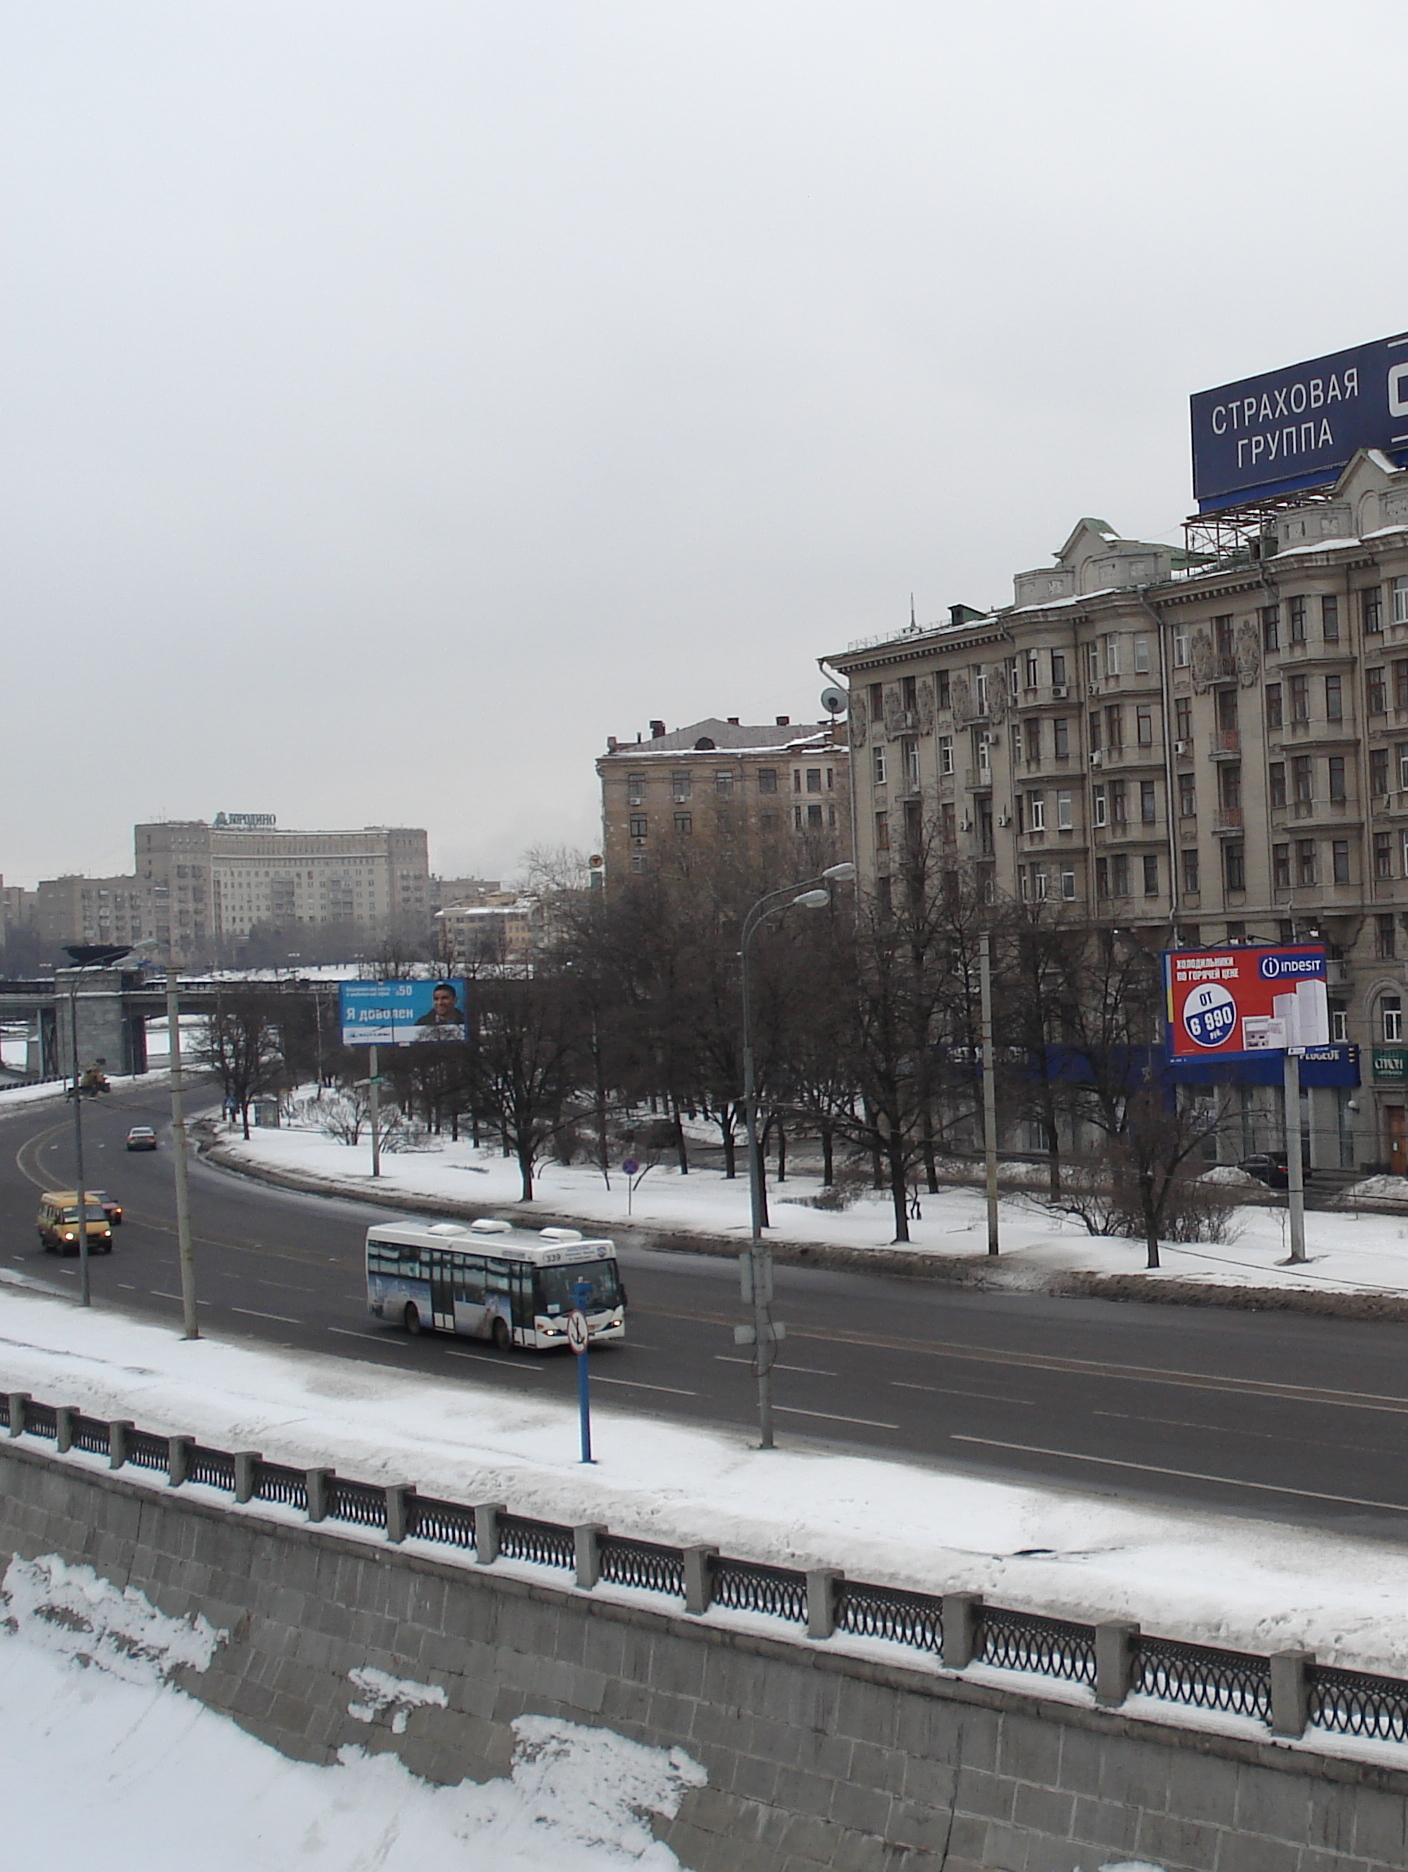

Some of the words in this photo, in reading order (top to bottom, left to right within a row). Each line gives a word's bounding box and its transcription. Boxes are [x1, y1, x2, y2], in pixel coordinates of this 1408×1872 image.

[1211, 367, 1359, 435] СТРАХОВАЯ
[1237, 417, 1334, 469] ГРУППА
[1199, 991, 1213, 1006] ОТ
[346, 1007, 356, 1021] Я
[1189, 1018, 1201, 1035] 6
[1204, 1006, 1233, 1031] 990
